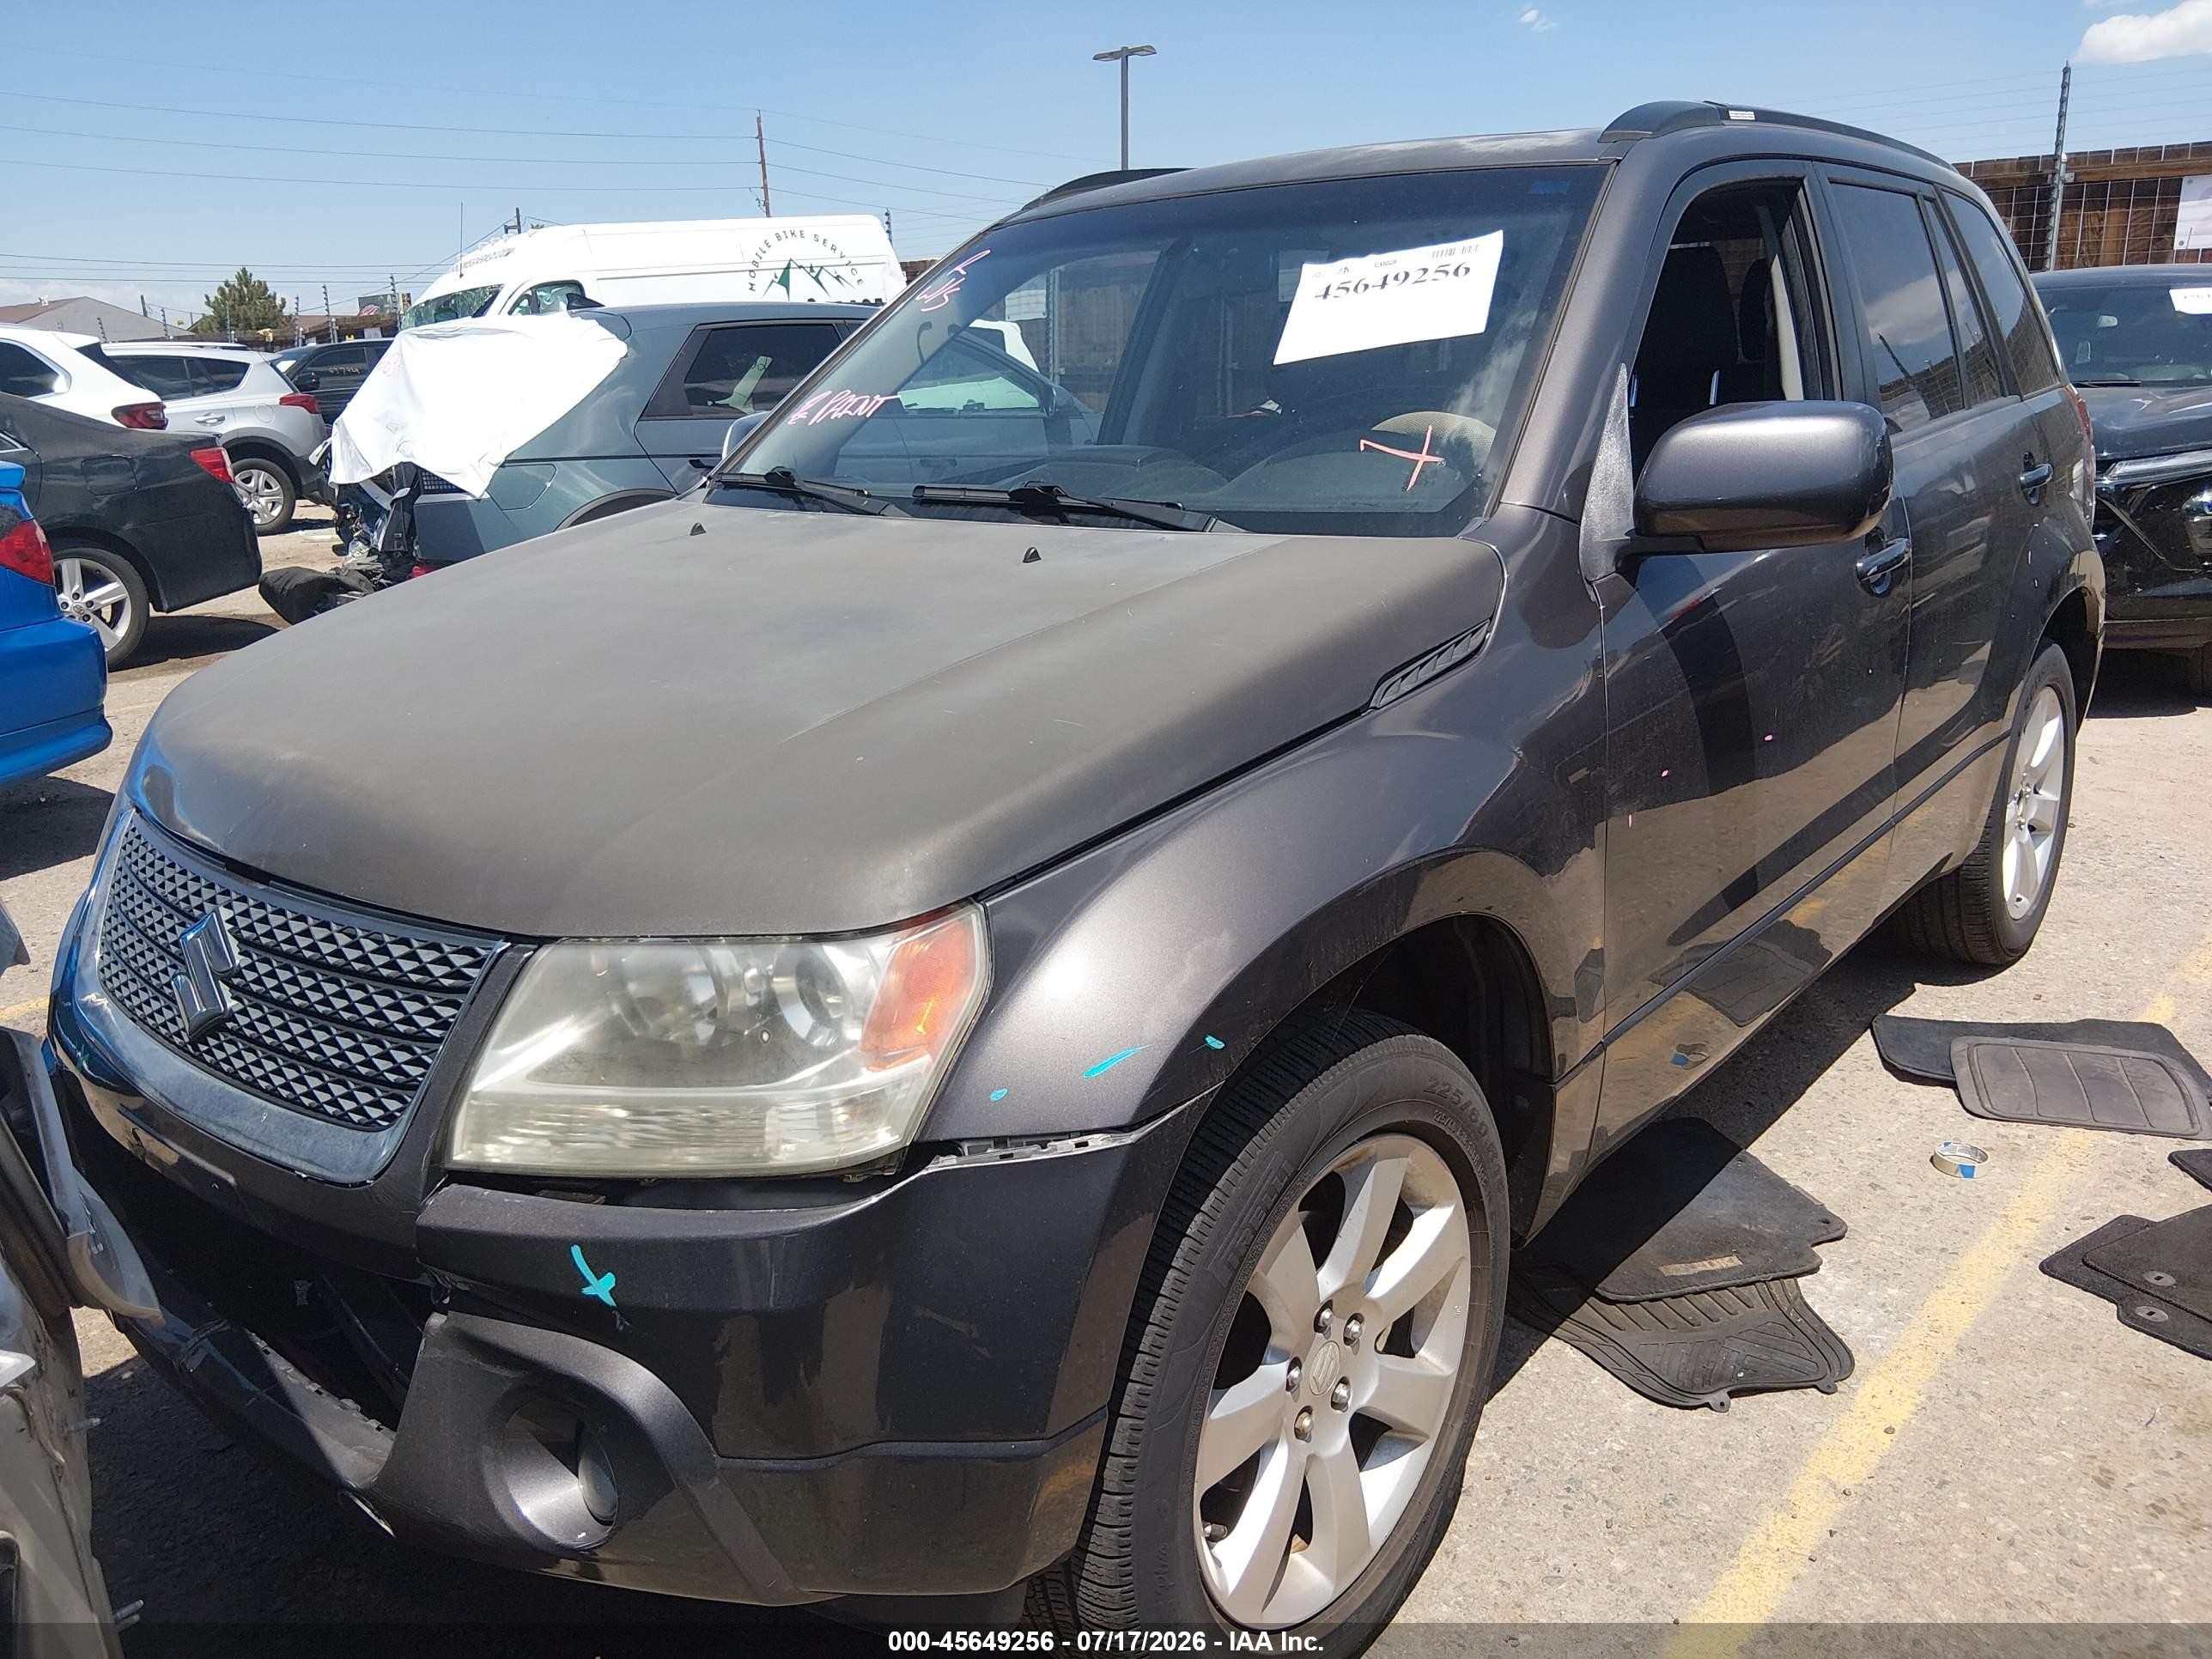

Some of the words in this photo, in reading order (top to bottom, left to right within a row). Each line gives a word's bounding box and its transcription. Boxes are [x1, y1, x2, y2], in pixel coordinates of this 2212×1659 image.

[748, 239, 772, 292] MOBILE
[775, 228, 805, 241] BIKE
[812, 234, 864, 286] SERVICE
[1314, 262, 1471, 301] 45649256
